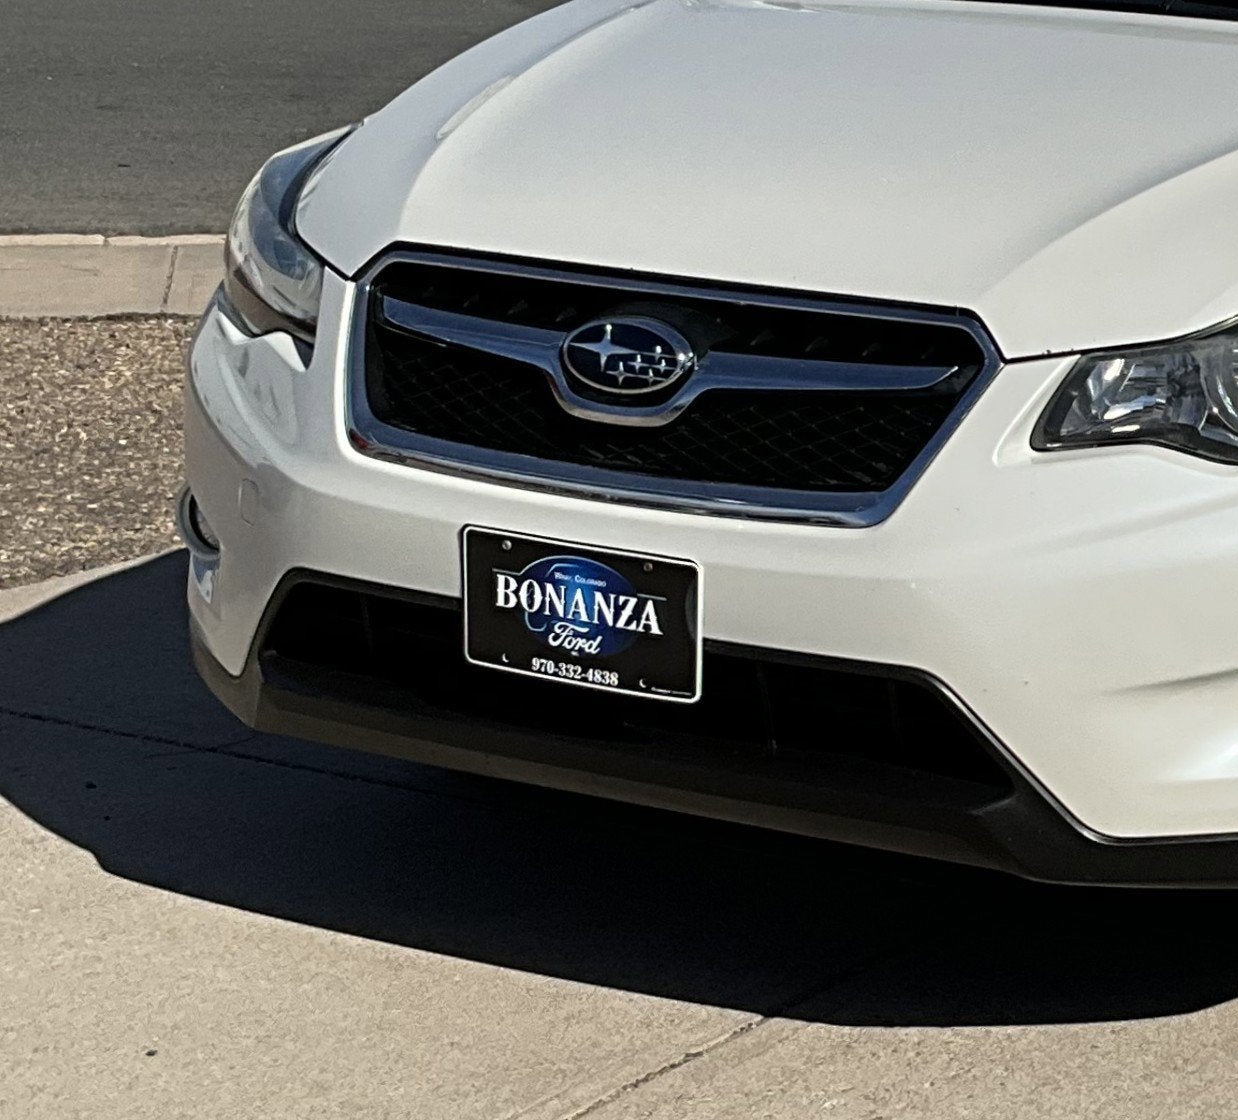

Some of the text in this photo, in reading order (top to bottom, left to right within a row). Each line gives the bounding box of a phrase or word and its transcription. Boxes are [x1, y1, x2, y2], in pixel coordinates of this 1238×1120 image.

[495, 574, 664, 635] BONANZA
[548, 621, 603, 655] Ford
[531, 657, 619, 687] 970-332-4838
